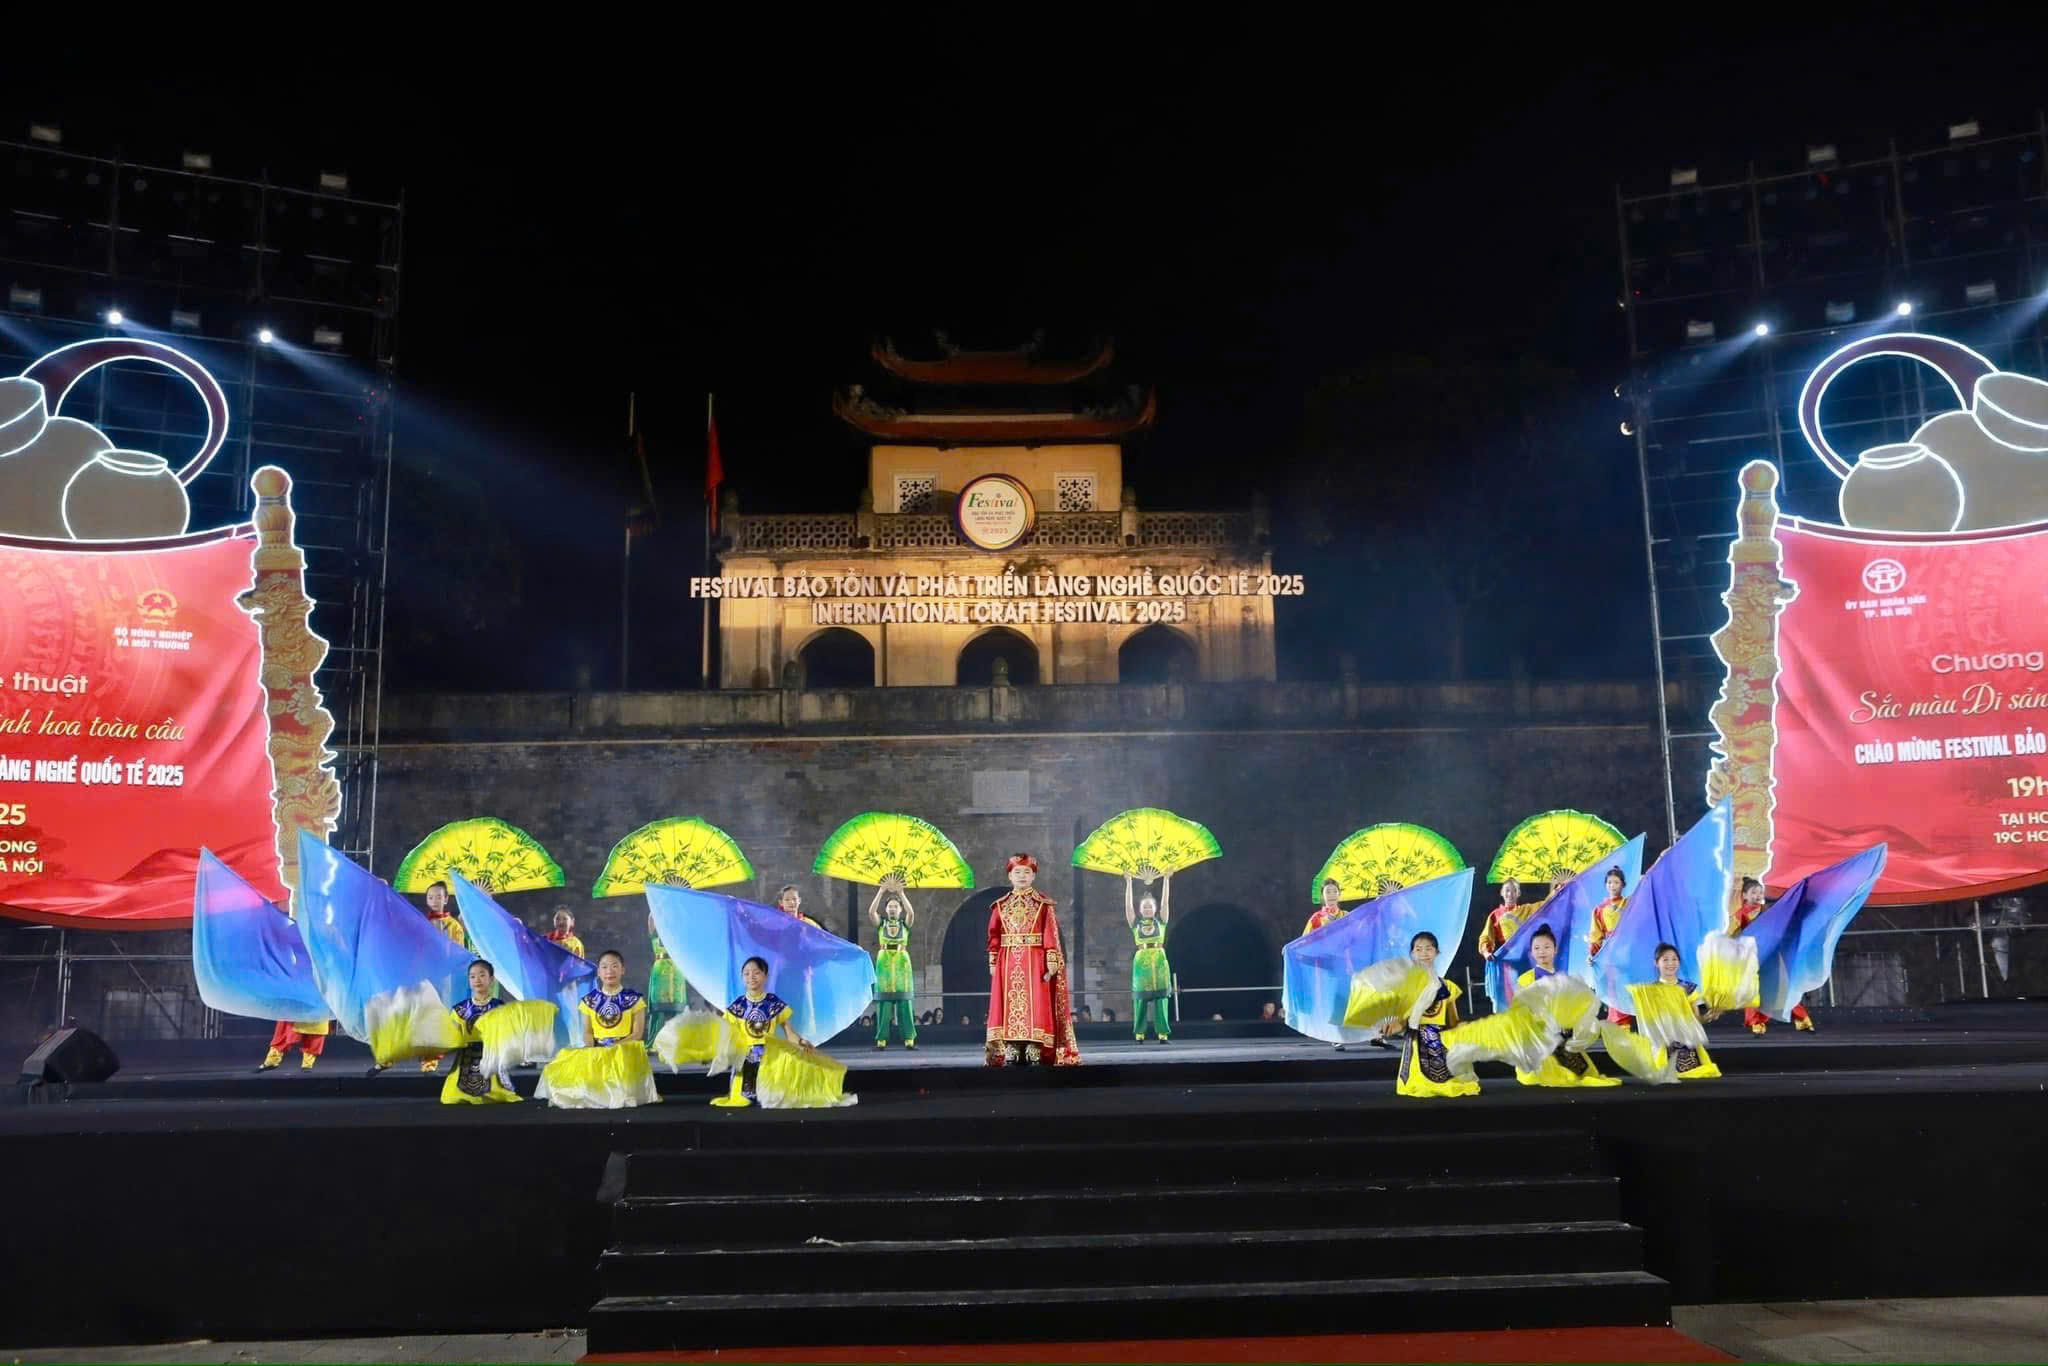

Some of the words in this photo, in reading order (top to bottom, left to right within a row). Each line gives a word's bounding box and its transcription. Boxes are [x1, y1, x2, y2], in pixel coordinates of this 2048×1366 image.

[690, 576, 779, 598] FESTIVAL
[783, 569, 829, 598] BẢO
[834, 567, 876, 597] TỒN
[881, 572, 912, 597] VÀ
[917, 571, 970, 596] PHÁT
[975, 565, 1028, 596] TRIỂN
[1034, 571, 1091, 597] LÀNG
[1096, 566, 1153, 596] NGHỀ
[1158, 567, 1222, 596] QUỐC
[1228, 570, 1249, 596] TẾ
[1256, 575, 1305, 596] 2025
[812, 602, 969, 624] INTERNATIONAL
[974, 602, 1039, 623] CRAFT
[1044, 602, 1132, 623] FESTIVAL
[1136, 601, 1186, 622] 2025
[1931, 651, 2045, 673] Chương
[12, 671, 88, 698] thuật
[1850, 690, 1902, 724] Sắc
[1908, 695, 1957, 716] màu
[2008, 687, 2048, 710] sản
[38, 710, 81, 736] hoa
[89, 716, 138, 738] toàn
[145, 717, 184, 740] cầu
[1855, 738, 1894, 764] CHÀO
[1945, 734, 2012, 759] FESTIVAL
[2014, 727, 2047, 755] BẢO
[0, 754, 31, 782] ÀNG
[80, 755, 123, 785] QUỐC
[126, 757, 145, 785] TẾ
[147, 764, 184, 786] 2025
[0, 803, 26, 825] 25
[1998, 812, 2024, 828] TẠI
[0, 840, 37, 853] ONG
[1993, 831, 2024, 844] 19C
[12, 857, 44, 876] NỘI
